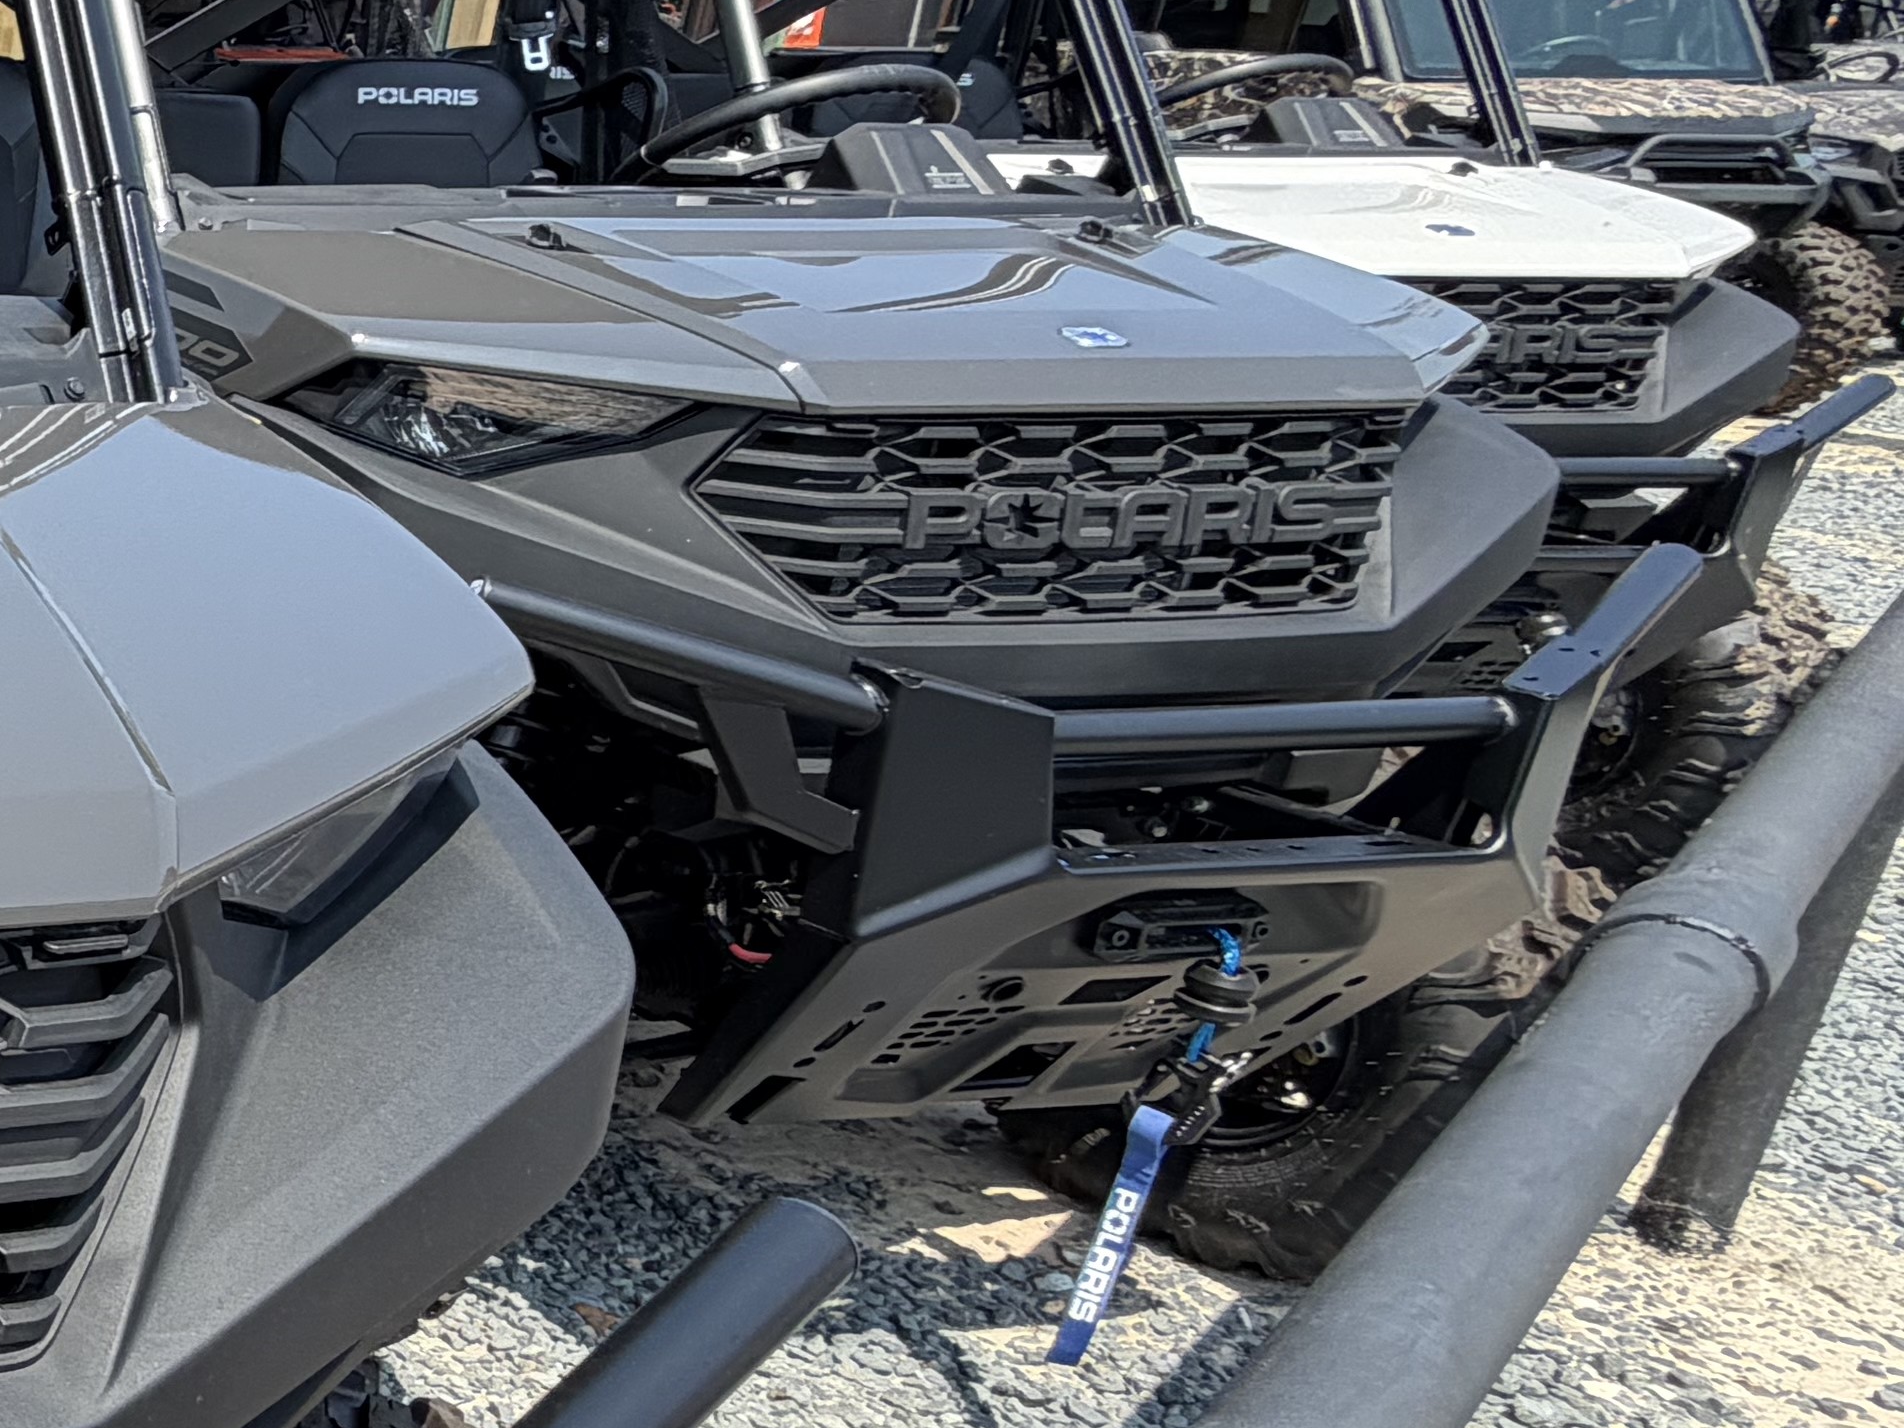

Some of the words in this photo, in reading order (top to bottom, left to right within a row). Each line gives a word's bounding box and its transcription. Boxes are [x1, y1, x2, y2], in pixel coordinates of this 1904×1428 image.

[357, 87, 480, 107] POLARIS
[901, 480, 1332, 550] POLARIS
[1068, 1187, 1141, 1323] POLARIS
